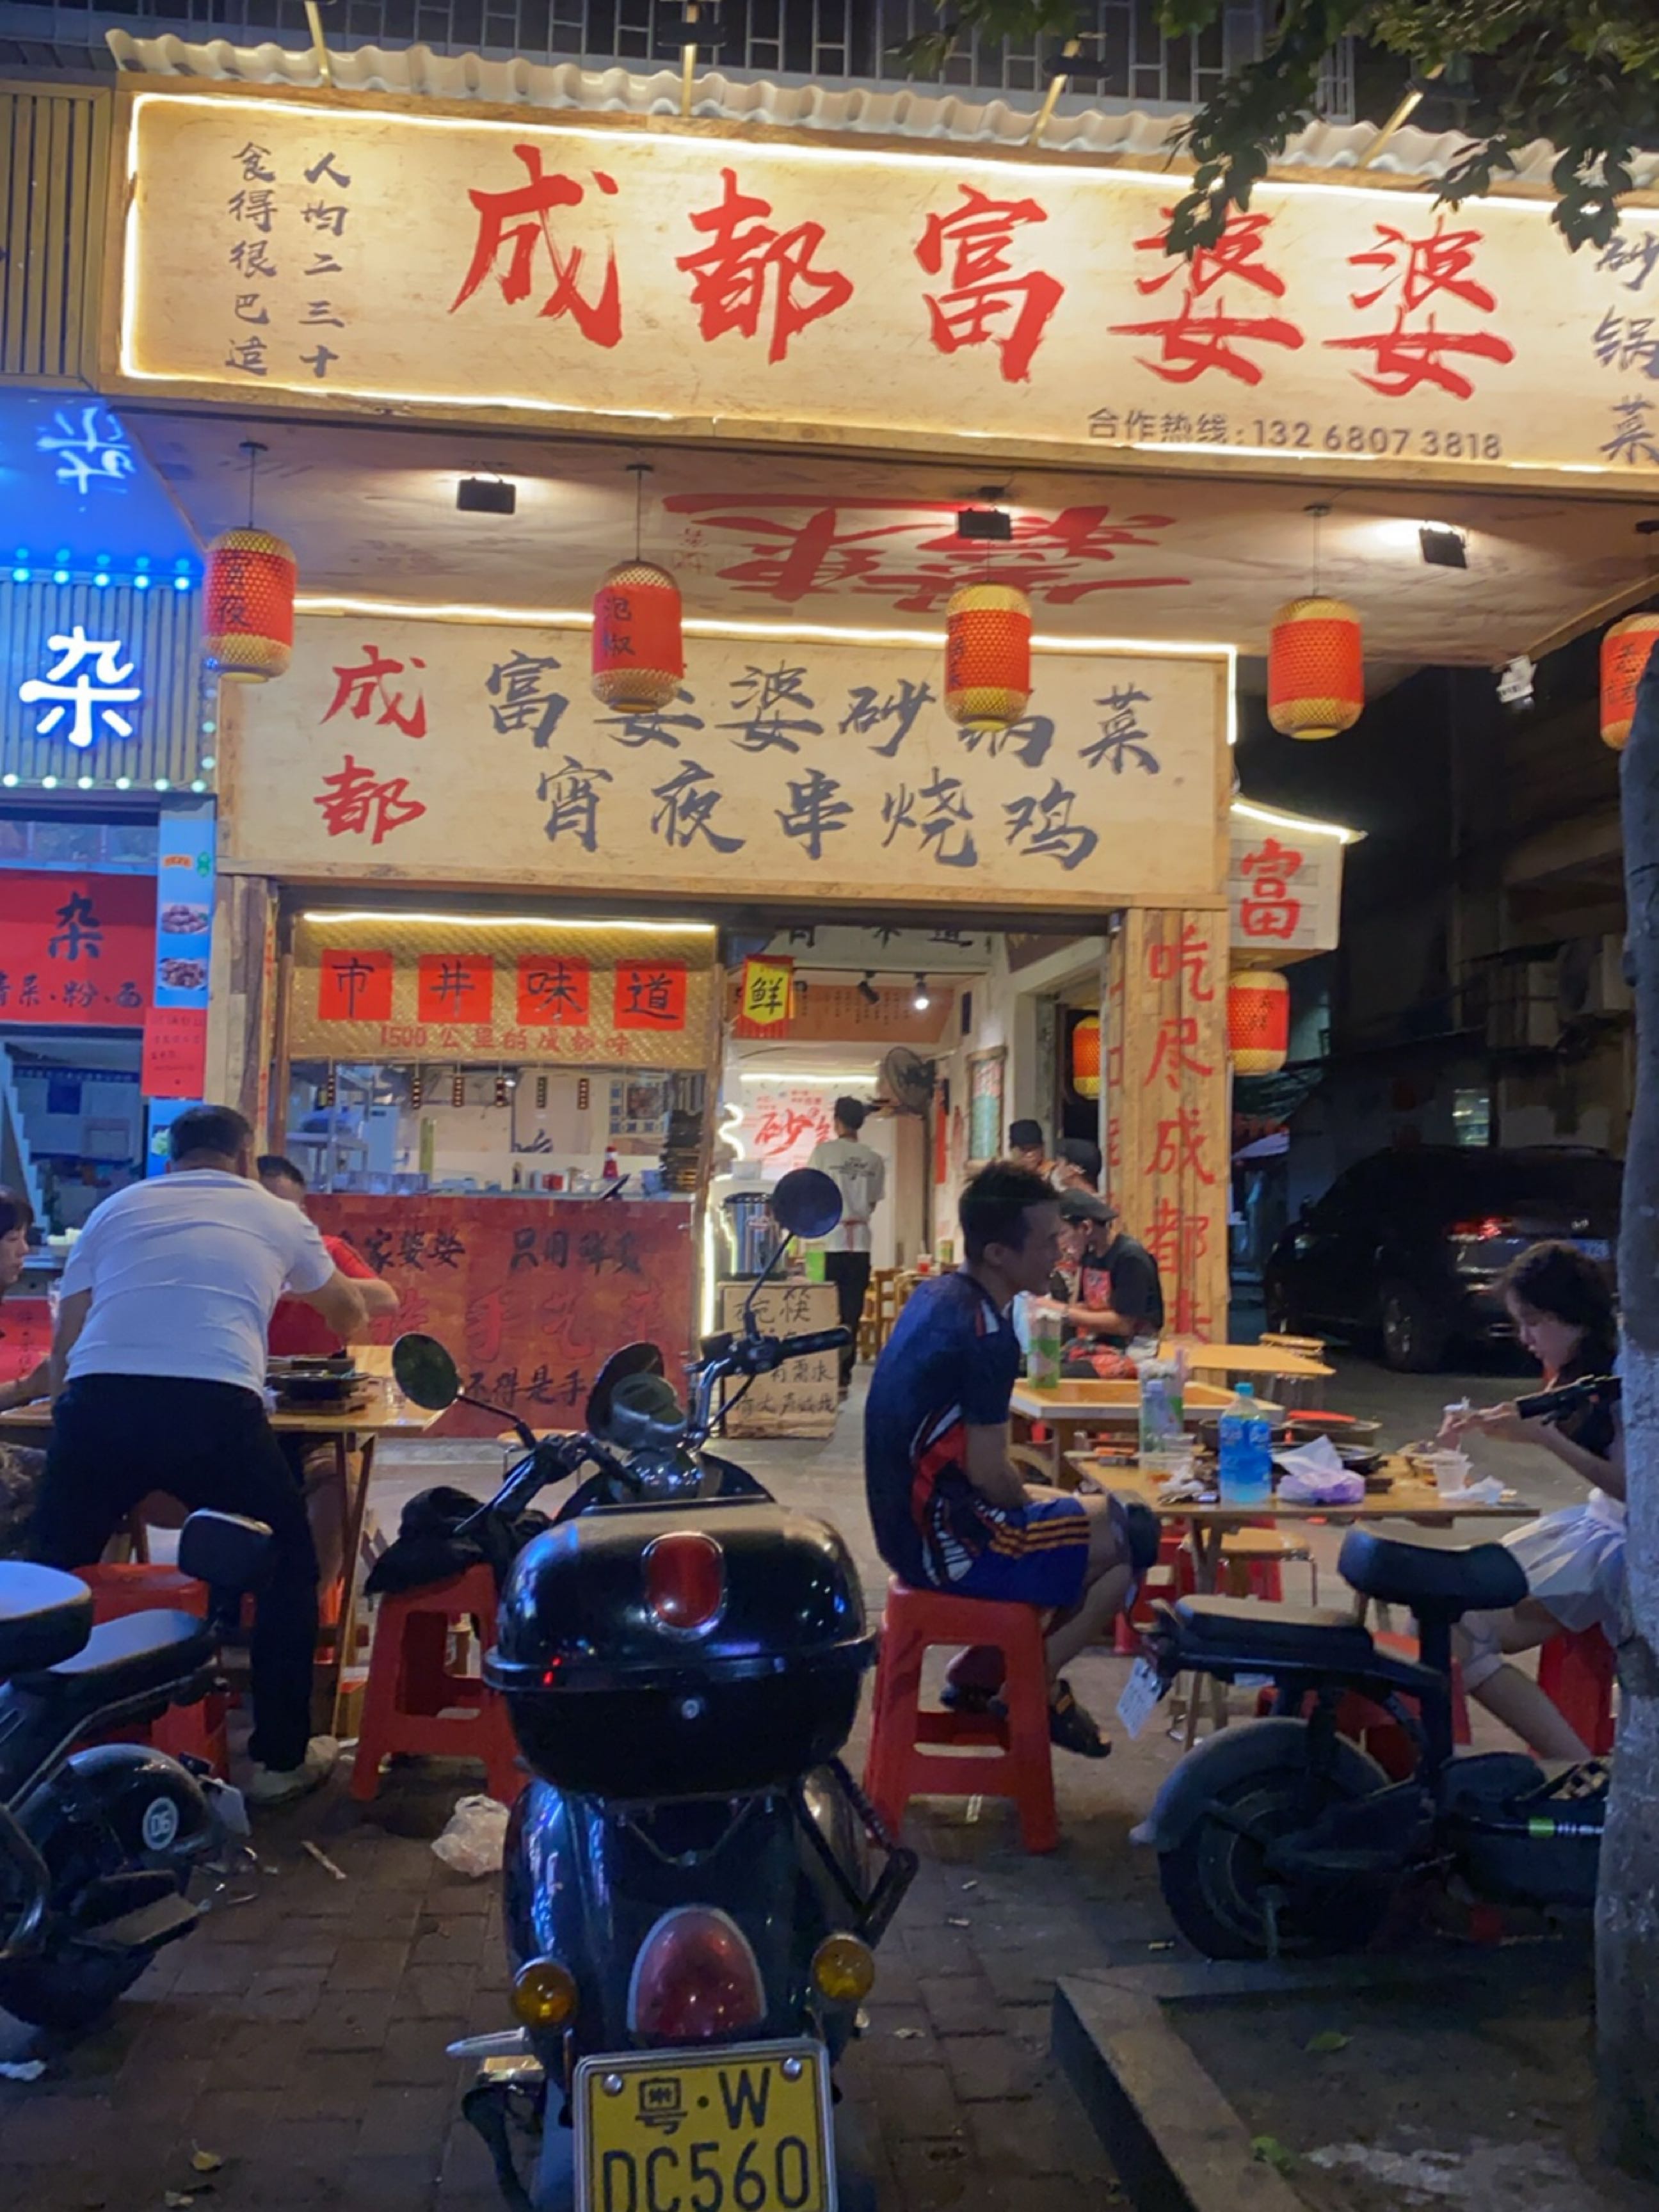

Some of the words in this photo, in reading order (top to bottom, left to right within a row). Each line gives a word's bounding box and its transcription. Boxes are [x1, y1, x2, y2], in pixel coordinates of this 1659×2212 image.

[298, 152, 351, 378] 人均二三十
[447, 143, 1516, 401] 成都富婆婆
[1322, 422, 1411, 456] 6807
[1420, 428, 1502, 461] 3818
[19, 626, 141, 748] 杂
[314, 645, 428, 845] 成都
[536, 755, 1100, 871] 宵夜串烧鸡
[47, 892, 104, 960] 杂
[1240, 837, 1304, 940] 富
[332, 957, 678, 1022] 市井味道
[749, 977, 783, 1015] 鲜
[603, 2135, 810, 2212] DC560
